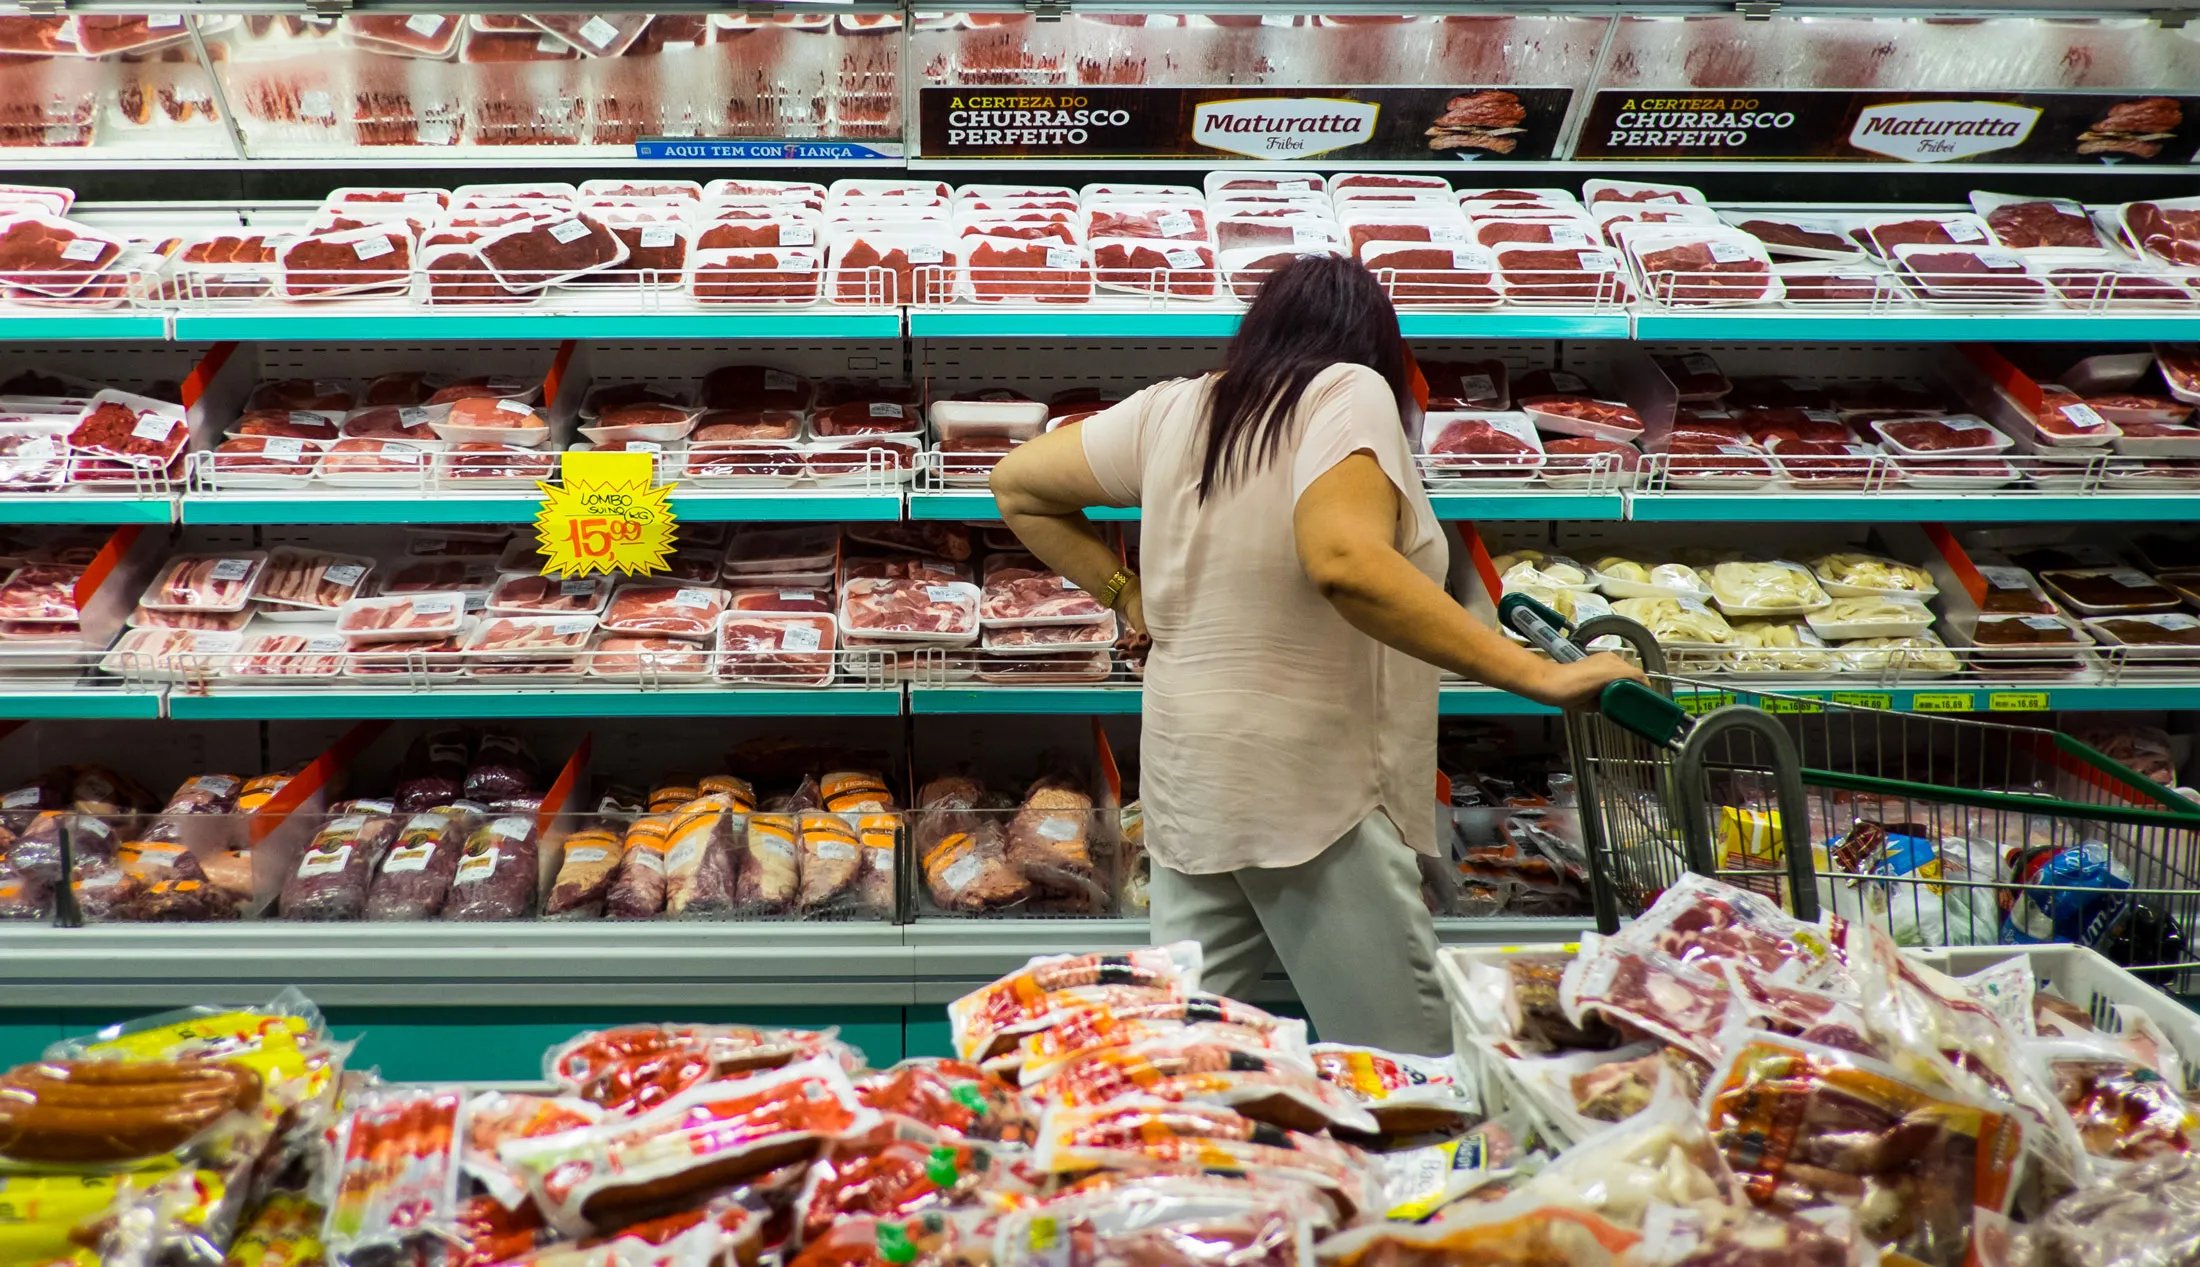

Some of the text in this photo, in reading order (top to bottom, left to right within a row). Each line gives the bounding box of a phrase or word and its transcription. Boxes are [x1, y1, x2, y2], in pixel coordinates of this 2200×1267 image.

[950, 96, 1088, 109] A CERTEZA DO
[1622, 98, 1760, 111] A CERTEZA DO
[948, 109, 1131, 127] CHURRASCO
[1204, 114, 1362, 133] Maturatta
[1615, 112, 1796, 129] CHURRASCO
[1861, 116, 2022, 137] Maturatta
[948, 128, 1089, 145] PERFEITO
[1266, 136, 1304, 151] Friboi
[1606, 130, 1748, 147] PERFEITO
[665, 146, 706, 157] AQUI
[711, 146, 745, 156] TEM
[1917, 139, 1956, 153] Friboi
[581, 493, 633, 506] LOMBO
[587, 506, 649, 520] SUINO KG
